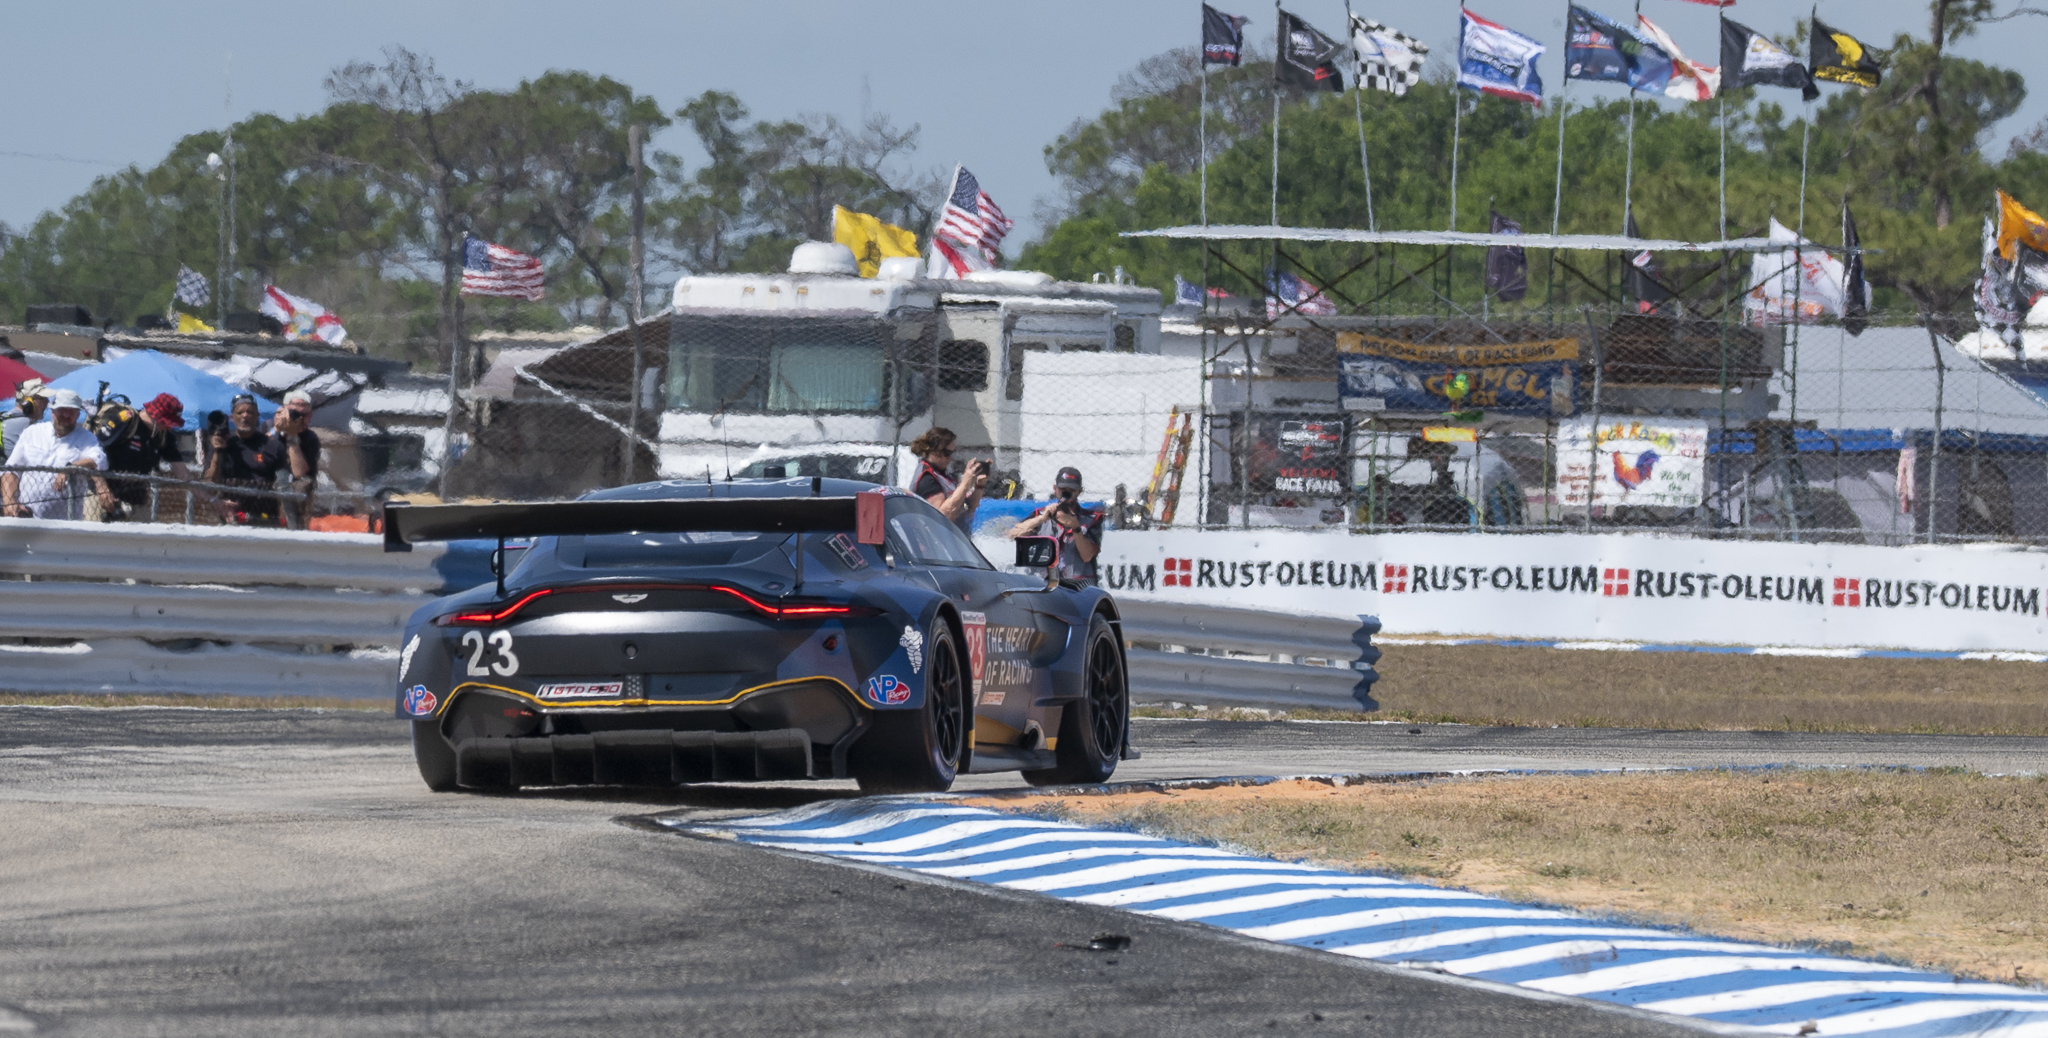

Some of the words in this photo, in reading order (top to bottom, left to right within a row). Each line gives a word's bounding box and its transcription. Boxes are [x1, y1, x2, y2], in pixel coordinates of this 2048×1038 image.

[1275, 477, 1304, 492] RACE
[463, 629, 520, 677] 23
[986, 627, 1004, 654] THE
[1004, 627, 1036, 653] HEART
[984, 660, 998, 687] OF
[998, 659, 1033, 686] RACING
[405, 684, 426, 715] VP
[554, 685, 585, 695] GTD
[587, 684, 620, 693] PRO
[868, 675, 898, 704] VP
